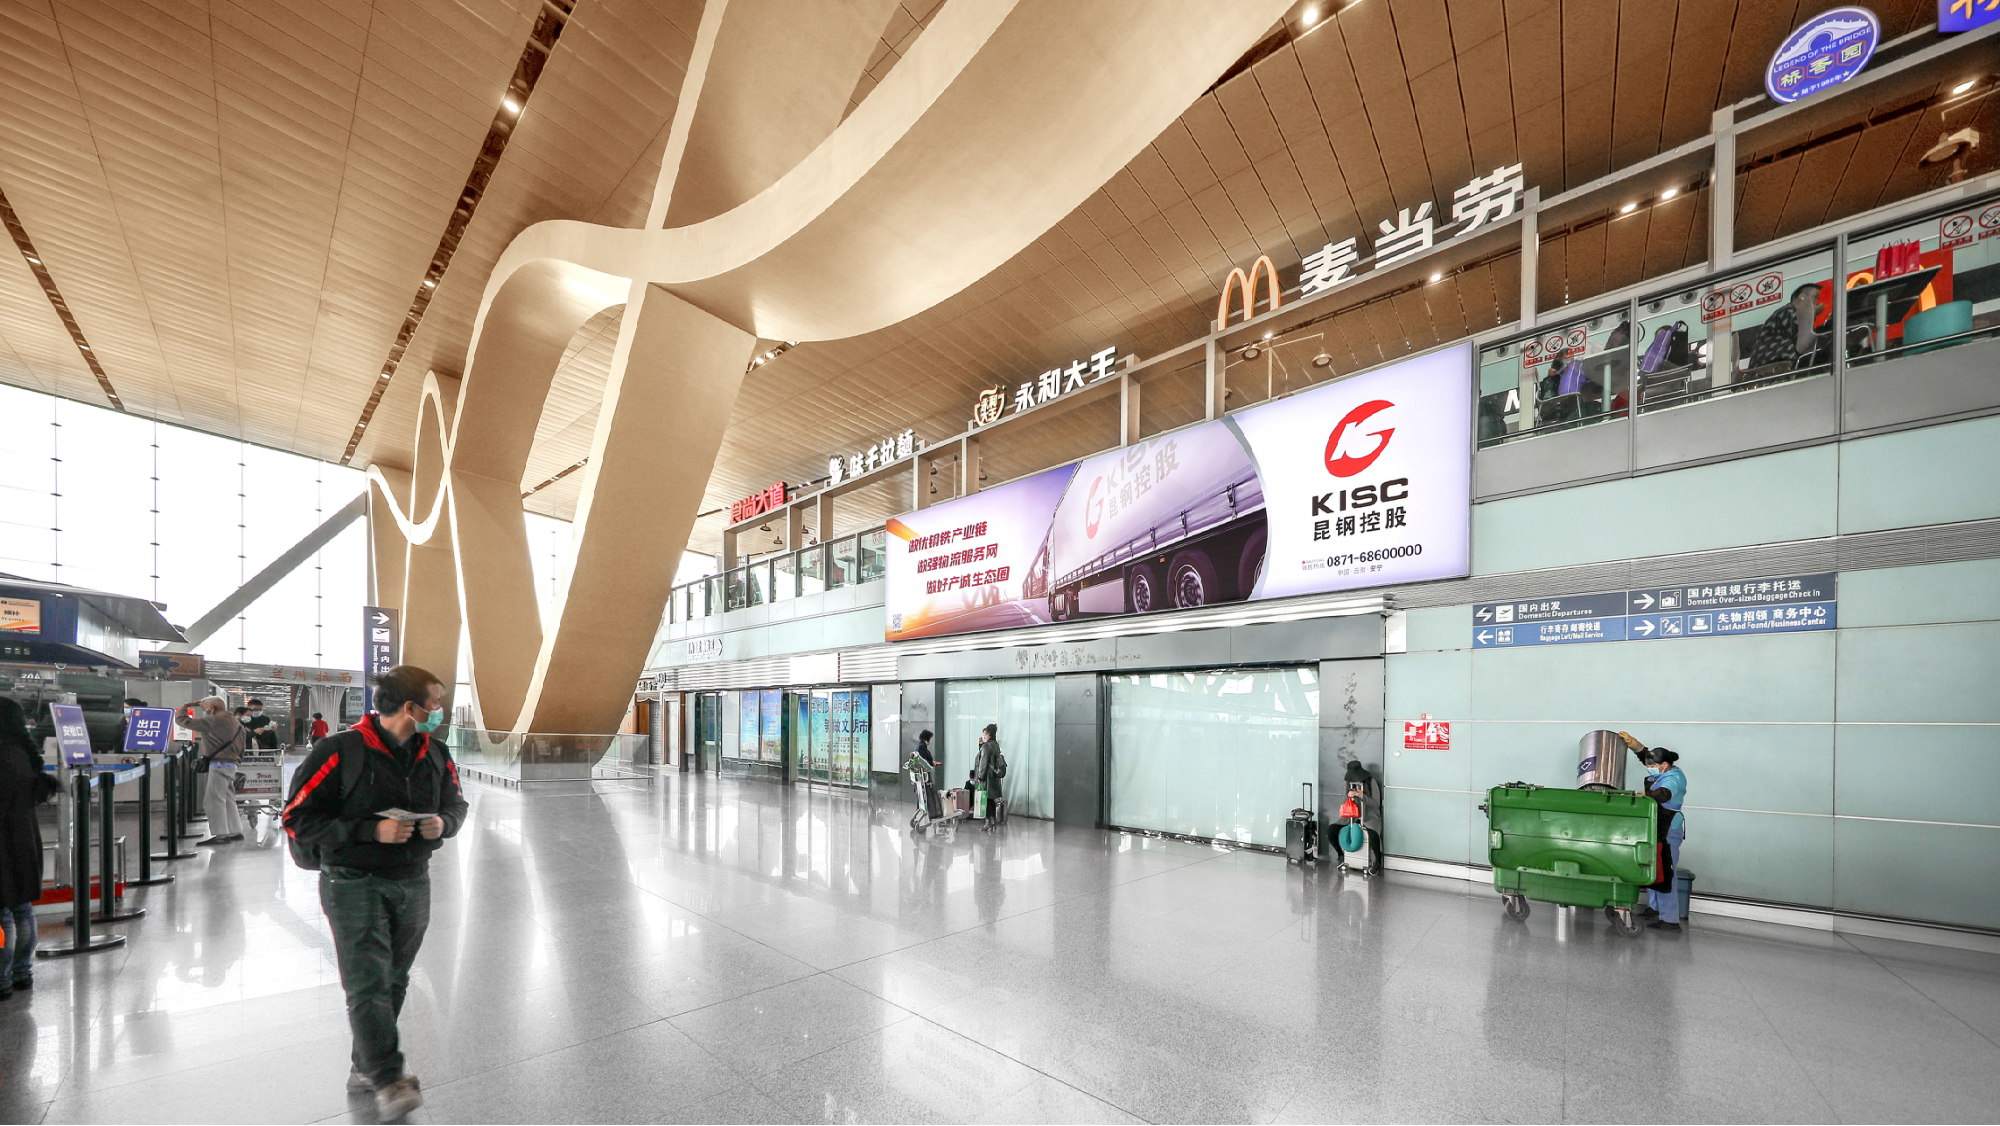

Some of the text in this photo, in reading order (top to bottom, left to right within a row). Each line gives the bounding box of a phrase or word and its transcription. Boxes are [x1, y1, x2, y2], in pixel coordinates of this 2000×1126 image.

[1773, 26, 1872, 74] LEGEND OF THE BRIDGE
[1299, 162, 1524, 300] 麦当劳
[1014, 345, 1116, 414] 永和大王
[1107, 439, 1160, 496] KIS
[1109, 438, 1180, 520] 昆钢控股
[730, 480, 785, 525] 食尚大道
[1311, 477, 1409, 517] KISC
[908, 521, 988, 553] 做优钢铁产业链
[1313, 506, 1407, 542] 昆钢控股
[917, 543, 998, 574] 做强物流服务网
[1326, 543, 1423, 568] 0871-68600000
[926, 566, 1010, 595] 做好产城生态圈
[1687, 580, 1802, 599] 国内超规行李托运
[1518, 601, 1561, 613] 国内出发
[1687, 597, 1718, 606] Domestic
[1719, 593, 1757, 604] Over-sized
[1757, 591, 1788, 602] Baggage
[1788, 590, 1811, 598] Check
[1518, 608, 1593, 620] Domestic Departures
[1717, 605, 1827, 623] 失物招领 商务中心
[1717, 623, 1732, 632] Lost
[1732, 621, 1745, 631] And
[1800, 617, 1826, 626] Center
[380, 645, 390, 673] 国内出
[268, 667, 353, 684] 兰州拉面
[62, 724, 84, 737] 安检口
[135, 729, 161, 738] EXIT
[136, 719, 161, 729] 出口
